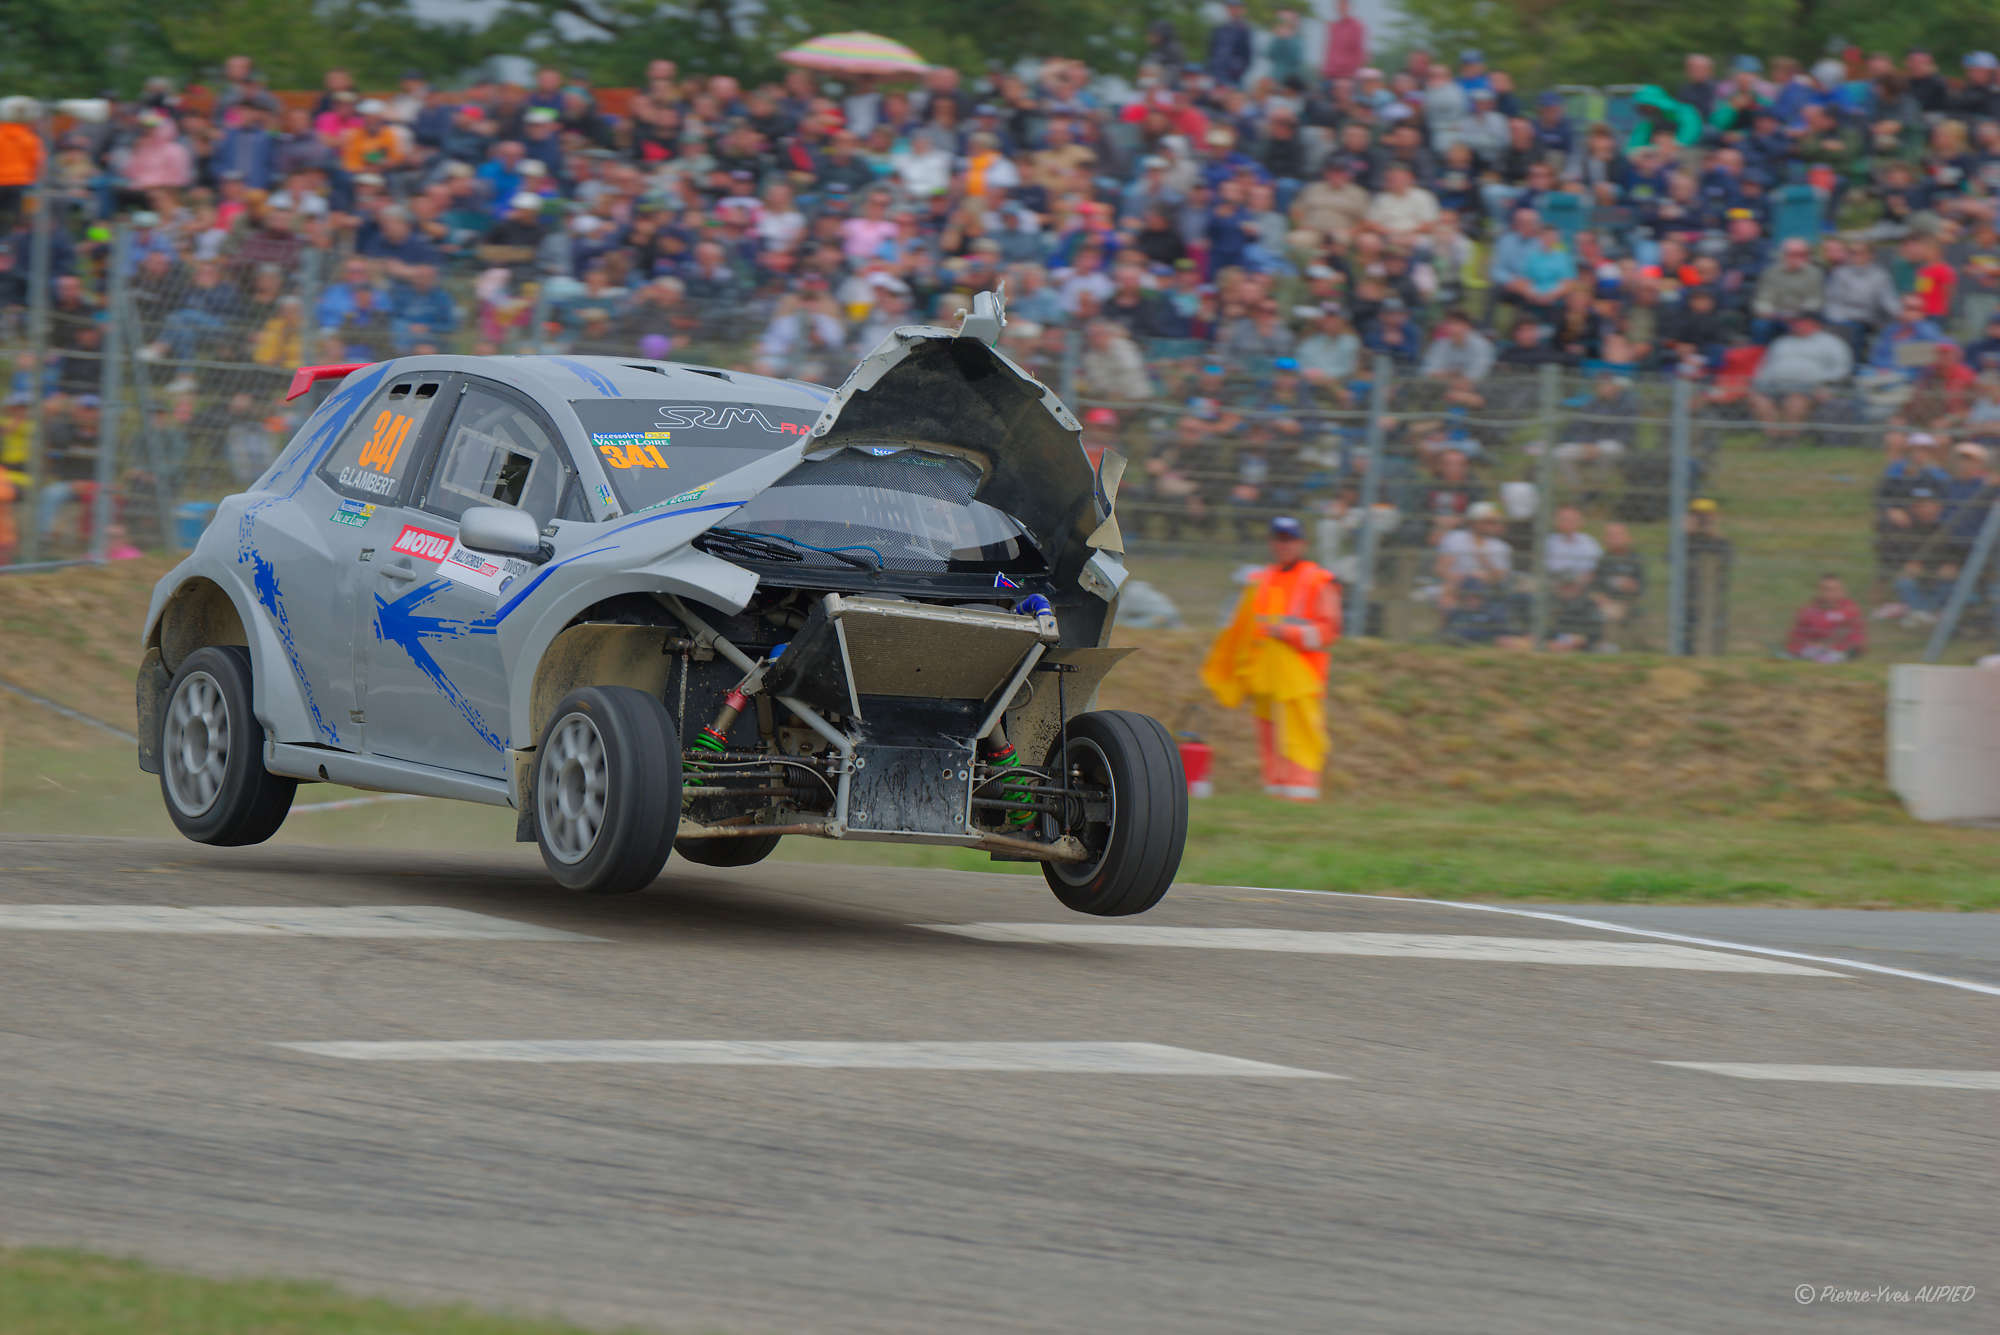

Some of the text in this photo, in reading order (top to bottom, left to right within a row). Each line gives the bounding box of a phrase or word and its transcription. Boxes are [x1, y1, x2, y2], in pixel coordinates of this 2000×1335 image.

[358, 410, 414, 474] 341
[599, 444, 670, 469] 341
[395, 530, 449, 560] MOTUL
